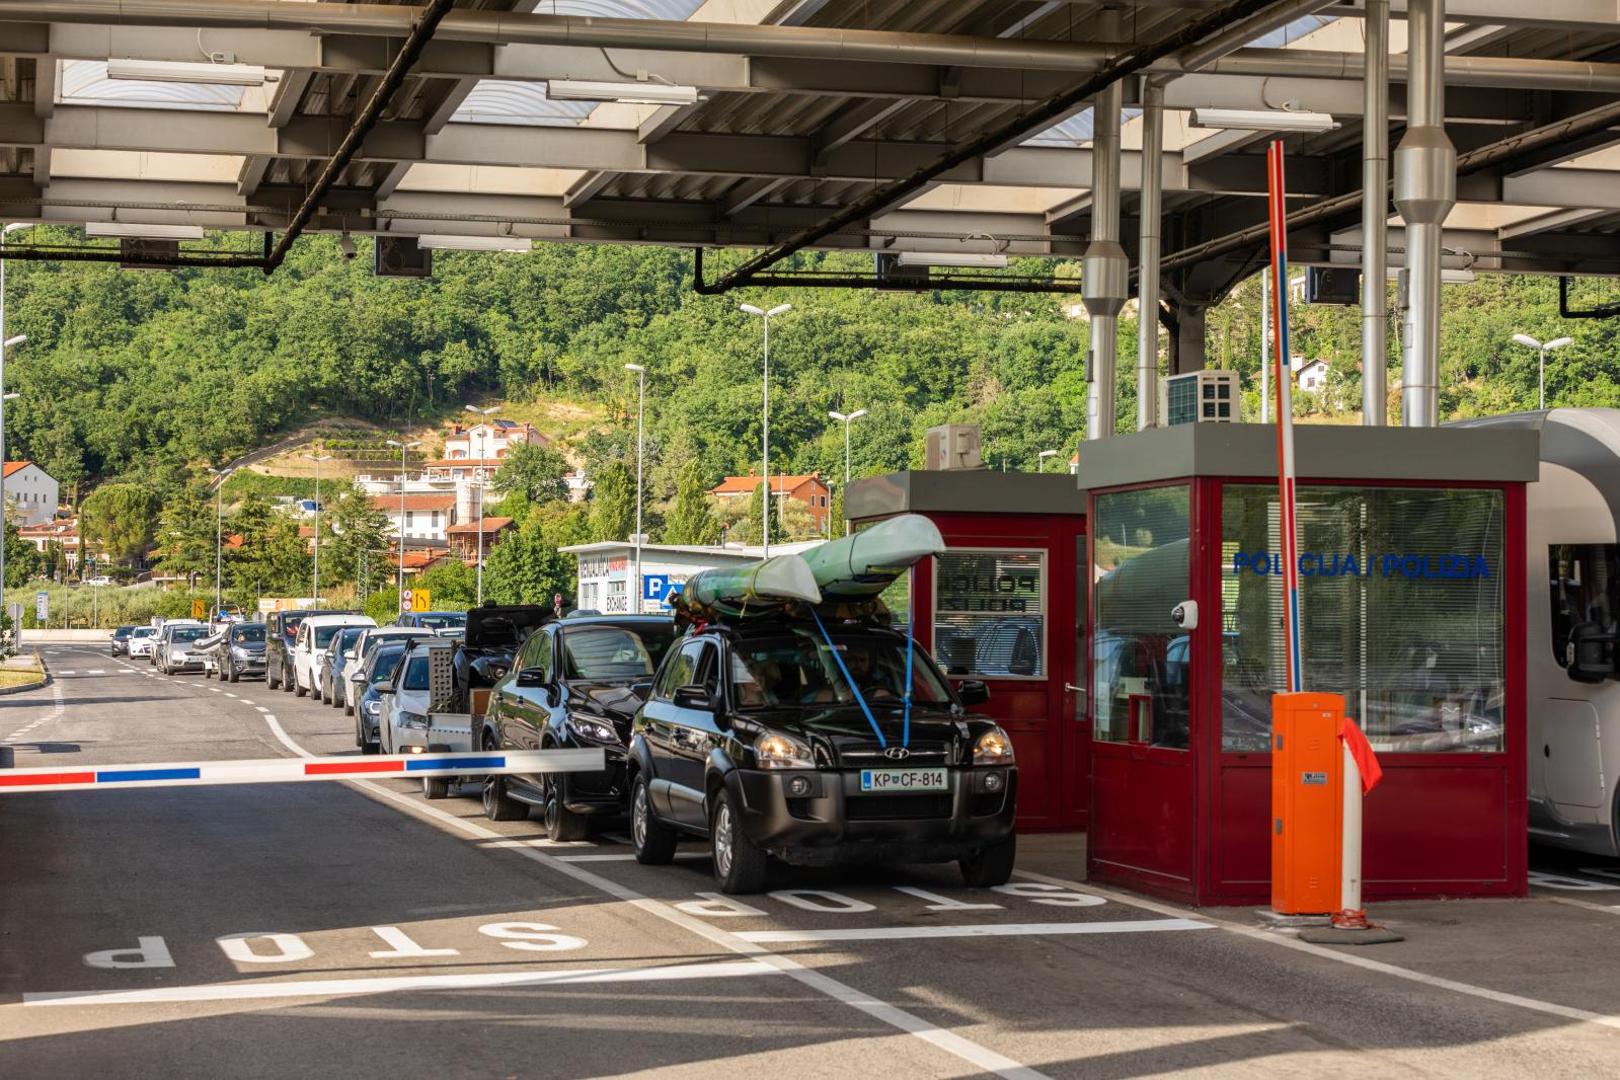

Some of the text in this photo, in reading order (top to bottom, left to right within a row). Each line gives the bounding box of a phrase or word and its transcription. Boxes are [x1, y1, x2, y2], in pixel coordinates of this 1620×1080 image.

[1233, 551, 1361, 577] POLCIJA
[1383, 554, 1489, 578] POLIZIA
[649, 578, 663, 596] P
[607, 596, 627, 611] EXCHANGE
[901, 772, 943, 786] CF-814
[673, 882, 1107, 917] STOP
[82, 921, 590, 969] STOP
